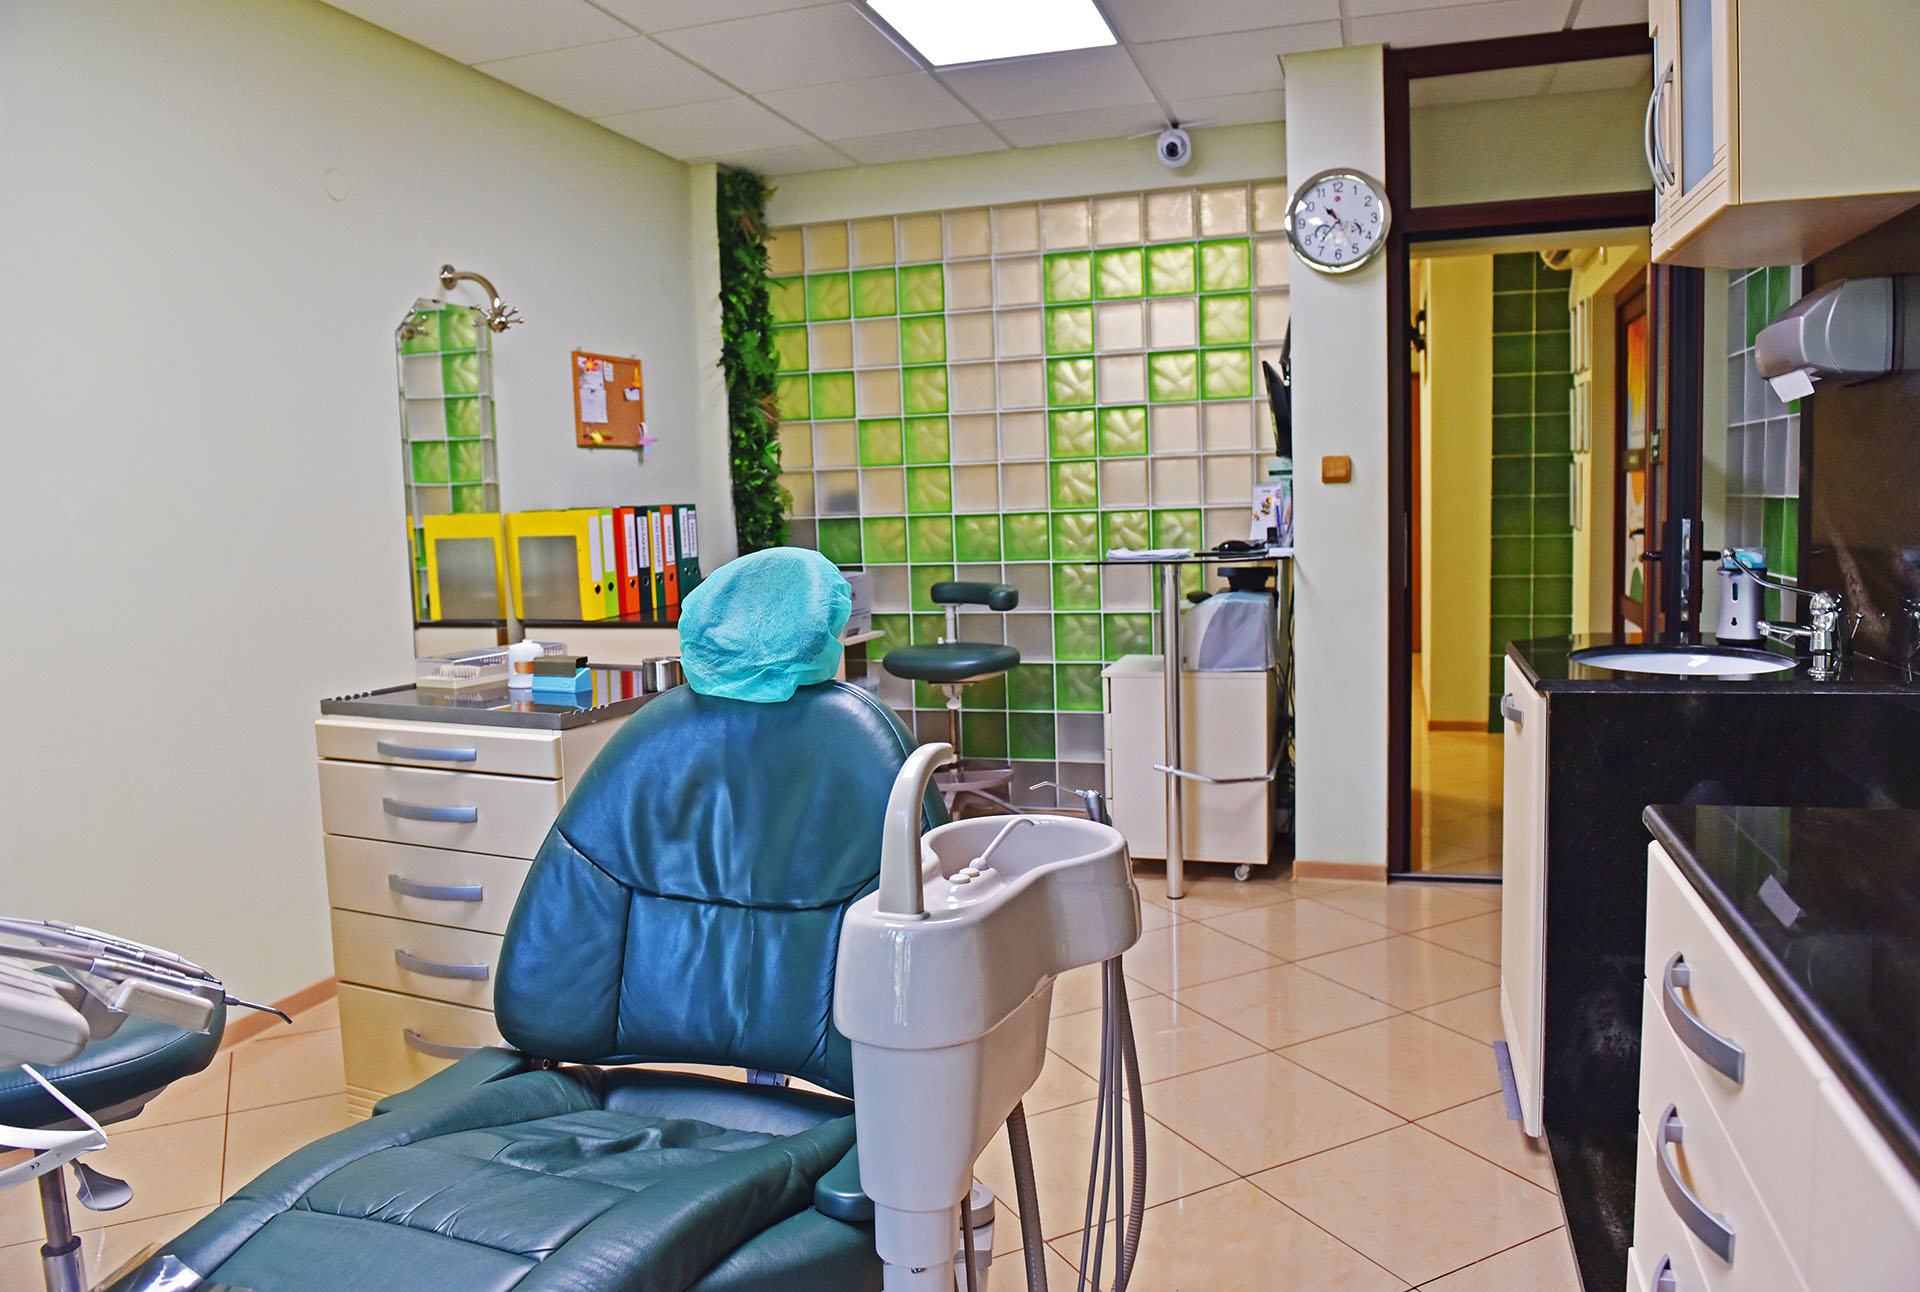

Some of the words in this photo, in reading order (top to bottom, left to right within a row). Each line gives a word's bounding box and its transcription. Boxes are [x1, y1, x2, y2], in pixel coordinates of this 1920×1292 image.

[1316, 187, 1326, 198] 11
[1332, 181, 1344, 193] 12
[1353, 184, 1358, 196] 1
[1364, 195, 1372, 207] 2
[1299, 218, 1306, 229] 9
[1371, 212, 1378, 223] 3
[1304, 234, 1312, 246] 8
[1365, 230, 1372, 240] 4
[1318, 245, 1325, 257] 7
[1334, 248, 1342, 260] 6
[1352, 243, 1360, 254] 5
